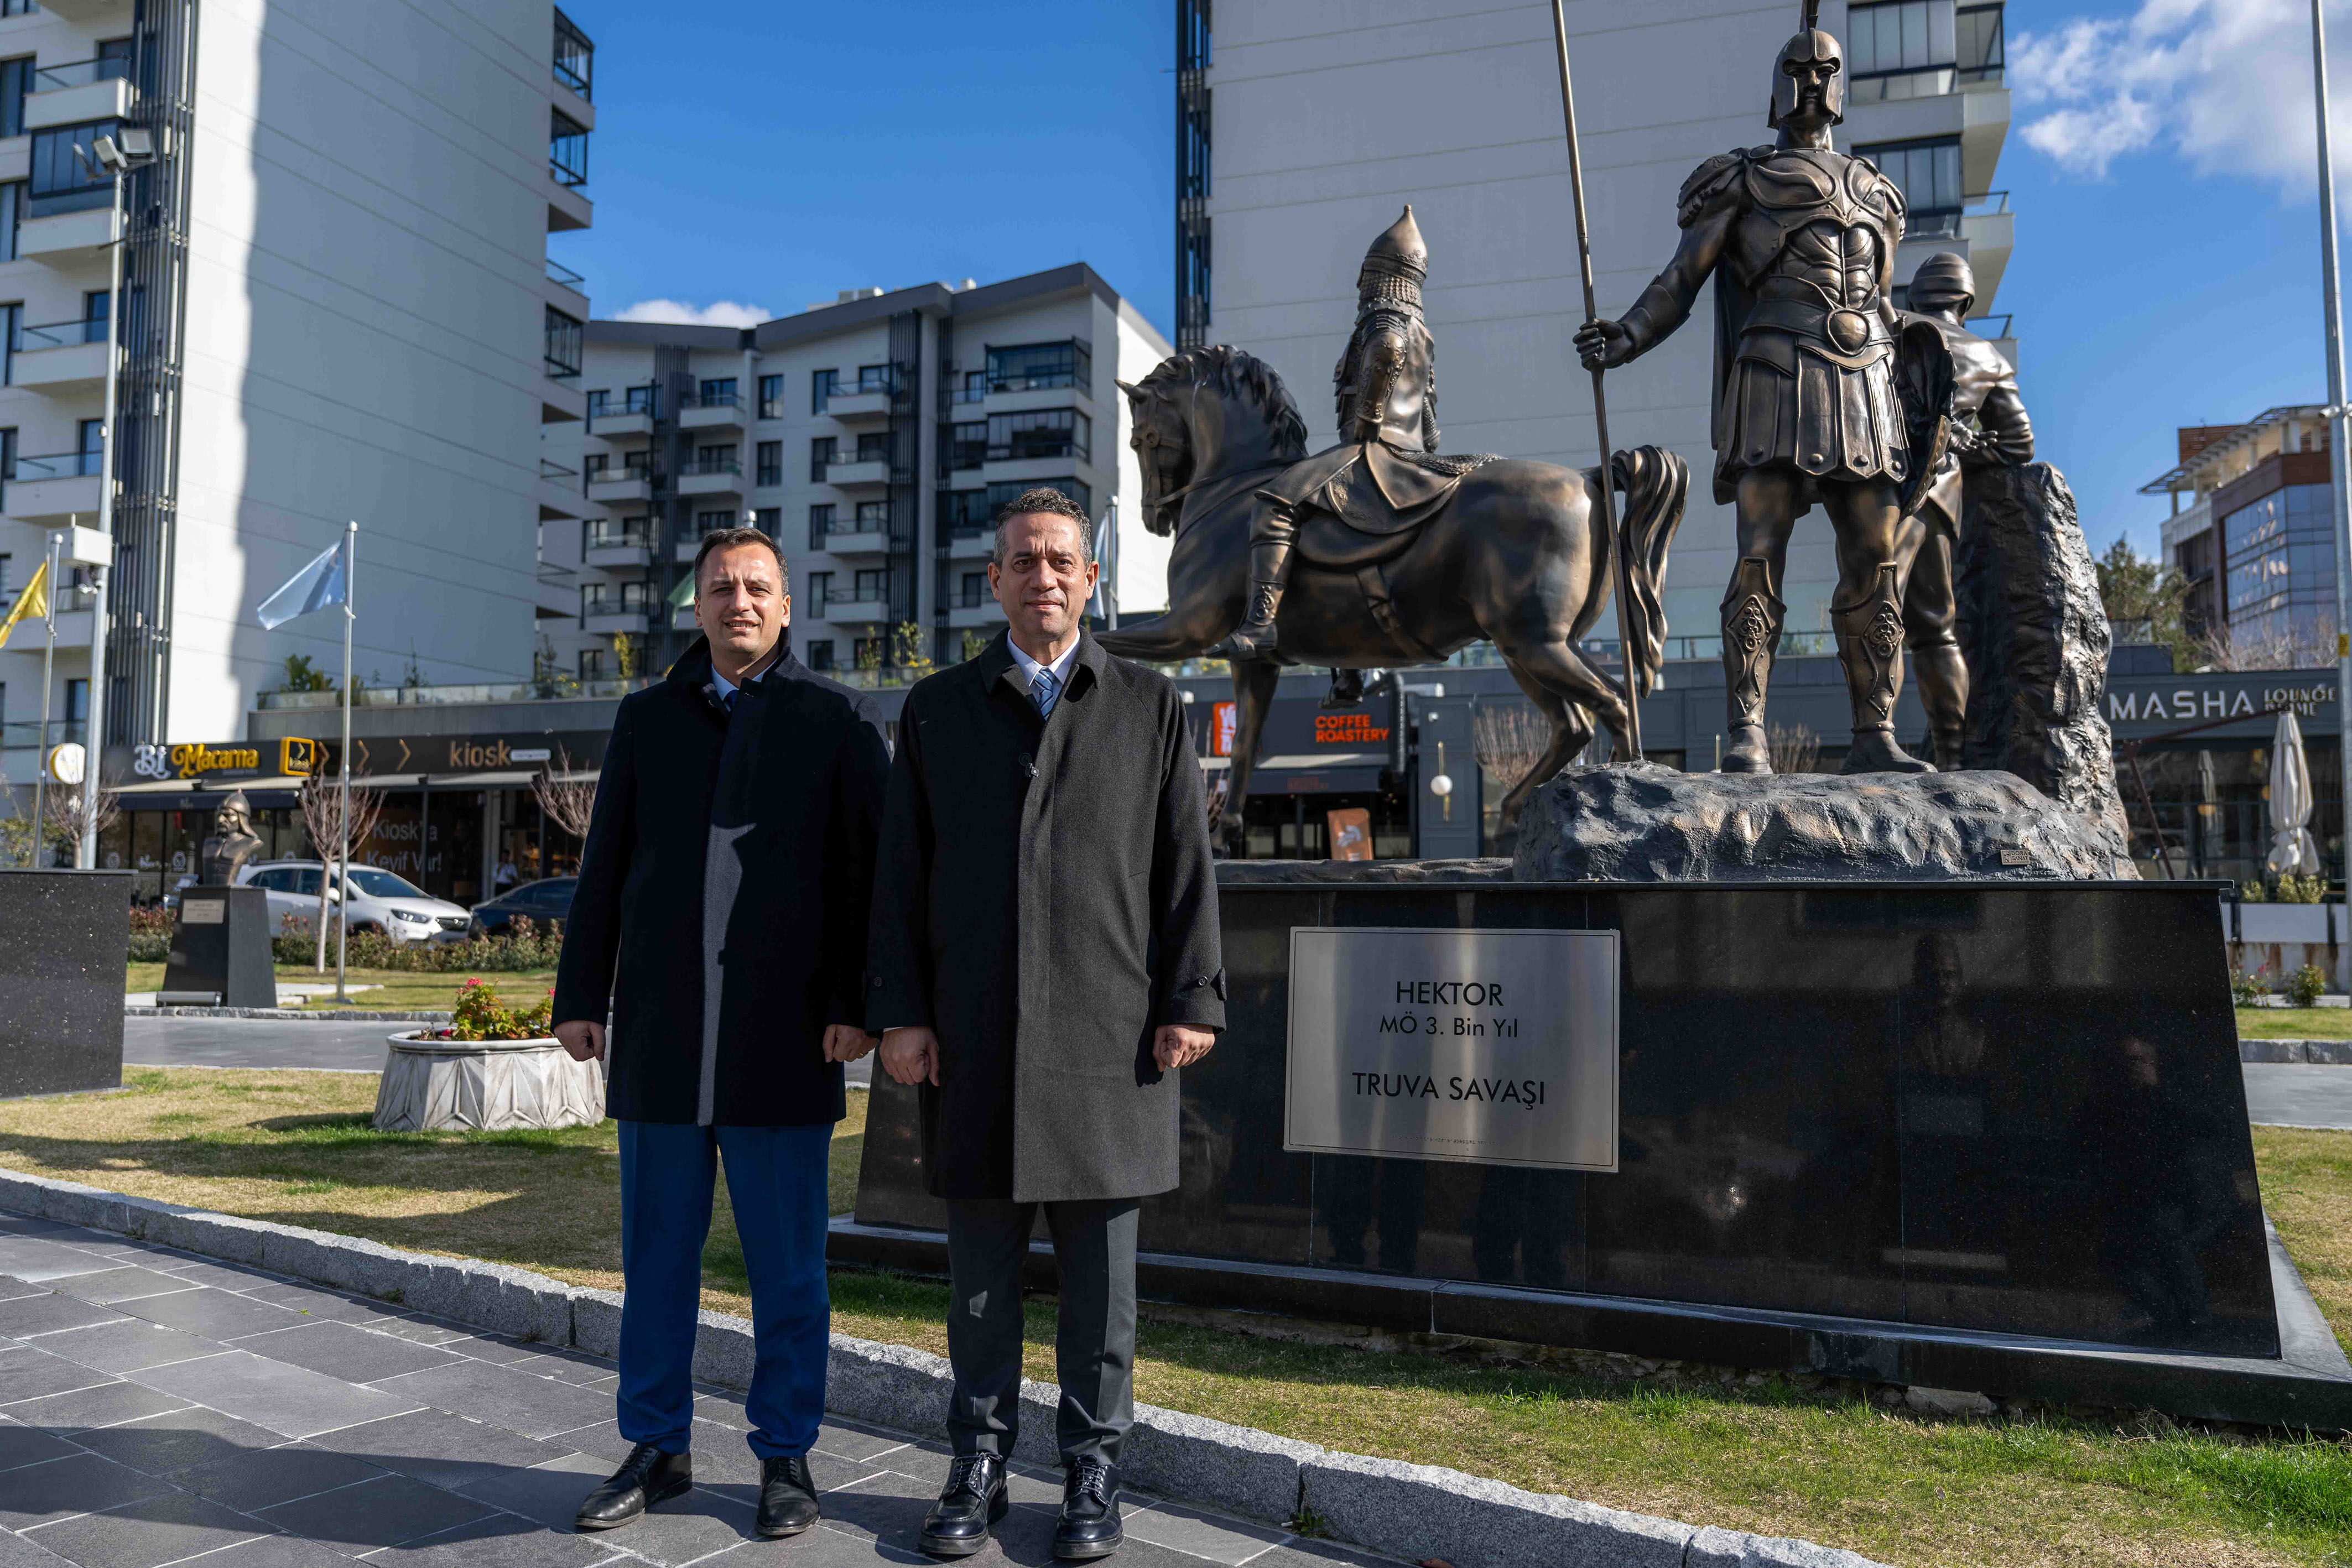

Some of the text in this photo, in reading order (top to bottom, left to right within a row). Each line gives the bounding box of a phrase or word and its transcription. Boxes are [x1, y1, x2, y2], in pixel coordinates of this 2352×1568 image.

[2109, 690, 2255, 721] MASHA
[1315, 714, 1371, 728] COFFEE
[1315, 728, 1390, 742] ROASTERY
[171, 743, 259, 779] Macarna
[450, 739, 512, 767] kiosk
[1396, 981, 1504, 1006] HEKTOR
[1379, 1010, 1518, 1038] MÖ 3. Bin Yıl
[1352, 1072, 1545, 1111] TRUVA SAVAŞI
